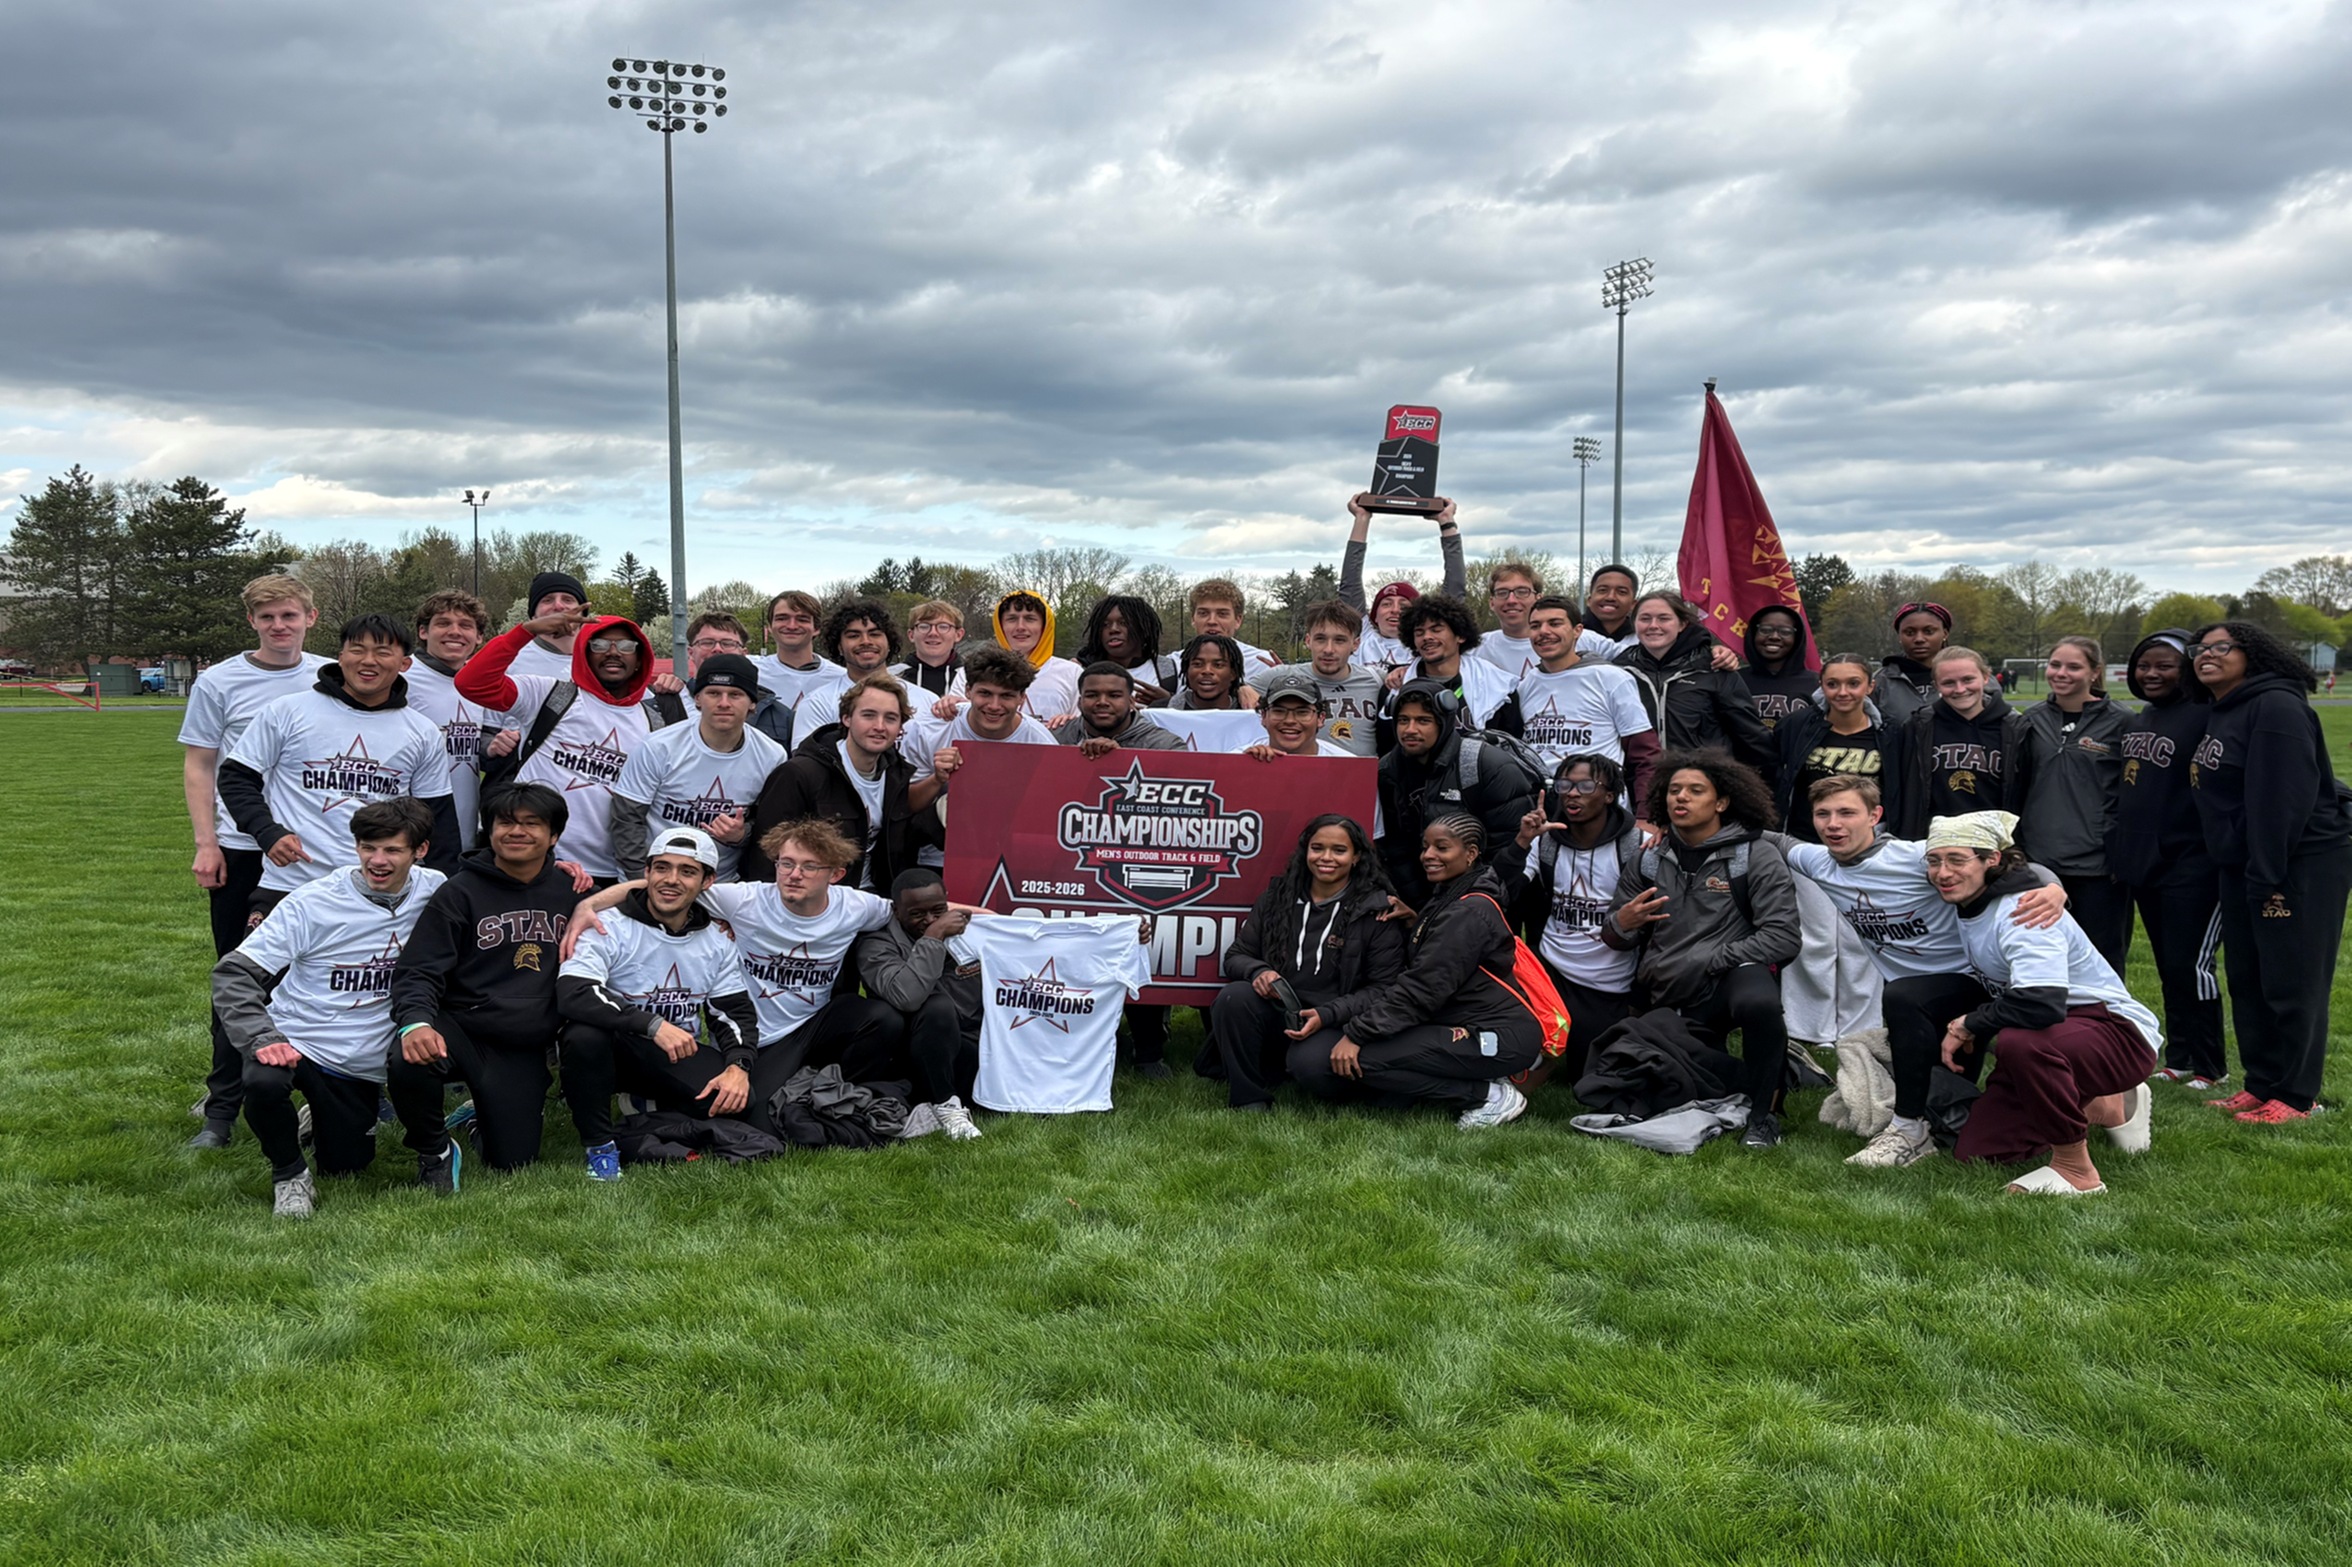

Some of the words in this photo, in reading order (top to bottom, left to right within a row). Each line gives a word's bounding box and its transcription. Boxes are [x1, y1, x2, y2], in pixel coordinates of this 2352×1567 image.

[1405, 418, 1434, 429] ECC
[1325, 697, 1377, 721] TAC
[1537, 717, 1564, 727] ECC
[453, 725, 477, 736] ECC
[446, 737, 481, 756] AMPIO
[2121, 732, 2176, 768] TAC
[2192, 734, 2224, 770] AC
[591, 749, 627, 766] ECC
[1806, 746, 1881, 774] STAC
[339, 760, 378, 774] ECC
[552, 749, 621, 783] CHAMPI
[302, 769, 401, 796] CHAMPIONS
[1135, 783, 1208, 806] ECC
[699, 801, 732, 812] ECC
[1116, 804, 1135, 813] EAST
[1136, 805, 1160, 814] COAST
[1161, 806, 1206, 816] CONFERENCE
[1064, 807, 1256, 853] CHAMPIONSHIPS
[1096, 849, 1122, 859] MEN'S
[1123, 850, 1160, 861] OUTDOOR
[1162, 851, 1189, 862] TRACK
[1190, 852, 1197, 862] &
[1198, 853, 1221, 863] FIELD
[1021, 880, 1086, 896] 2025-2026
[1856, 912, 1887, 923] ECC
[1854, 917, 1930, 942] AMPIONS
[780, 959, 815, 969] ECC
[1031, 982, 1065, 996] ECC
[656, 991, 689, 1004] ECC
[995, 987, 1096, 1015] CHAMPIONS
